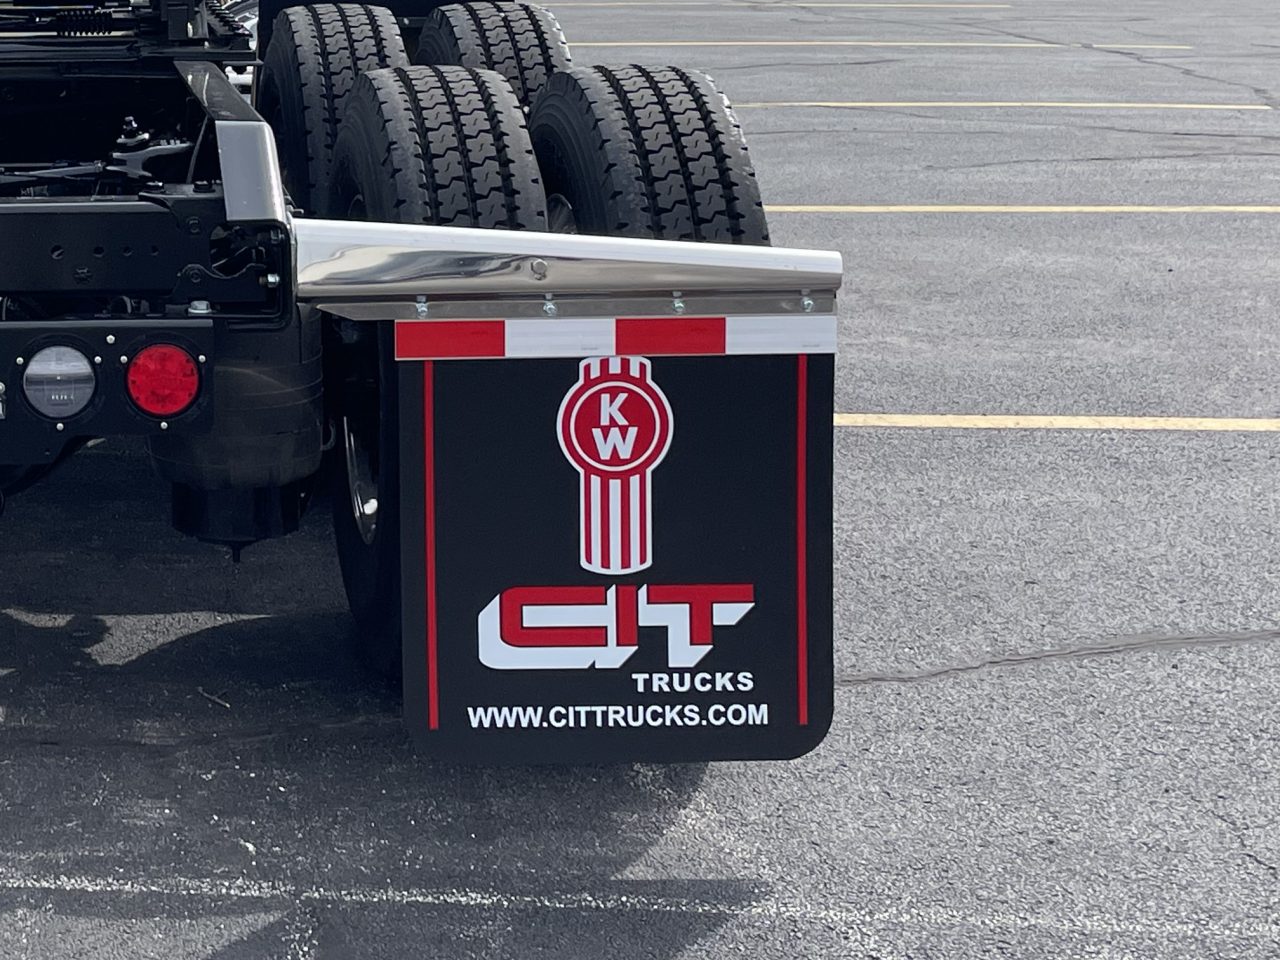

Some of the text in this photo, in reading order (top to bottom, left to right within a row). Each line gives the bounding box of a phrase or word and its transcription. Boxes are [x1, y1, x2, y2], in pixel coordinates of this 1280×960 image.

[478, 583, 755, 669] CIT
[632, 671, 755, 693] TRUCKS
[467, 703, 769, 728] WWW.CITTRUCKS.COM
